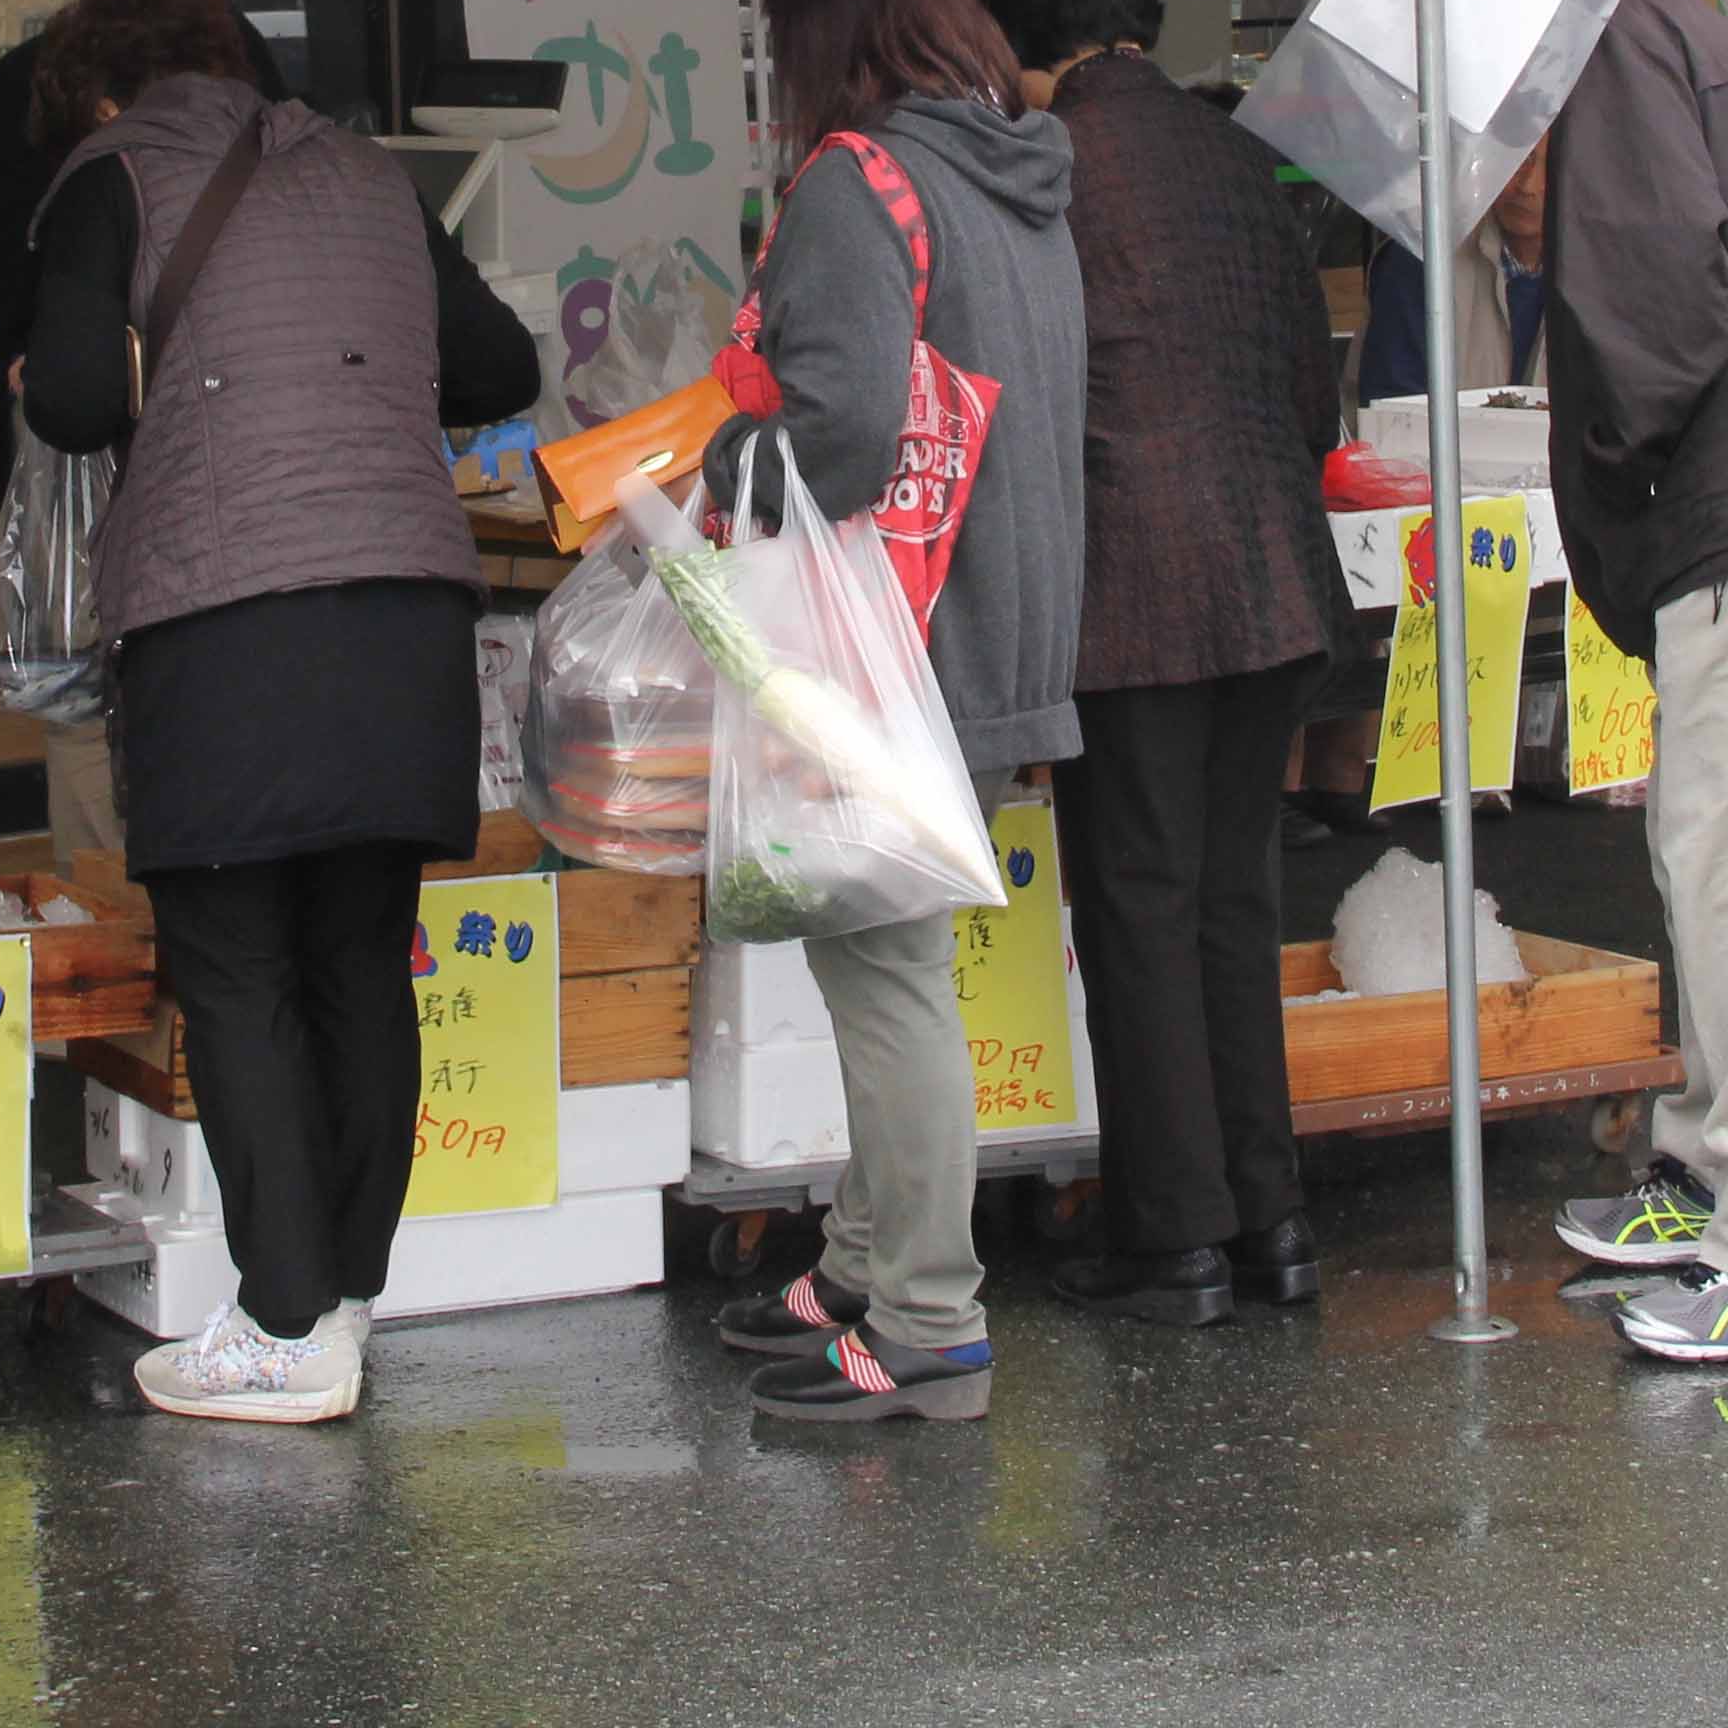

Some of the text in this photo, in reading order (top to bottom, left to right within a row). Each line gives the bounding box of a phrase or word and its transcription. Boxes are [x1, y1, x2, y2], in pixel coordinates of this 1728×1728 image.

[899, 440, 967, 479] ADER
[1470, 525, 1516, 572] 祭り
[1006, 845, 1036, 889] り
[454, 910, 534, 963] 祭り
